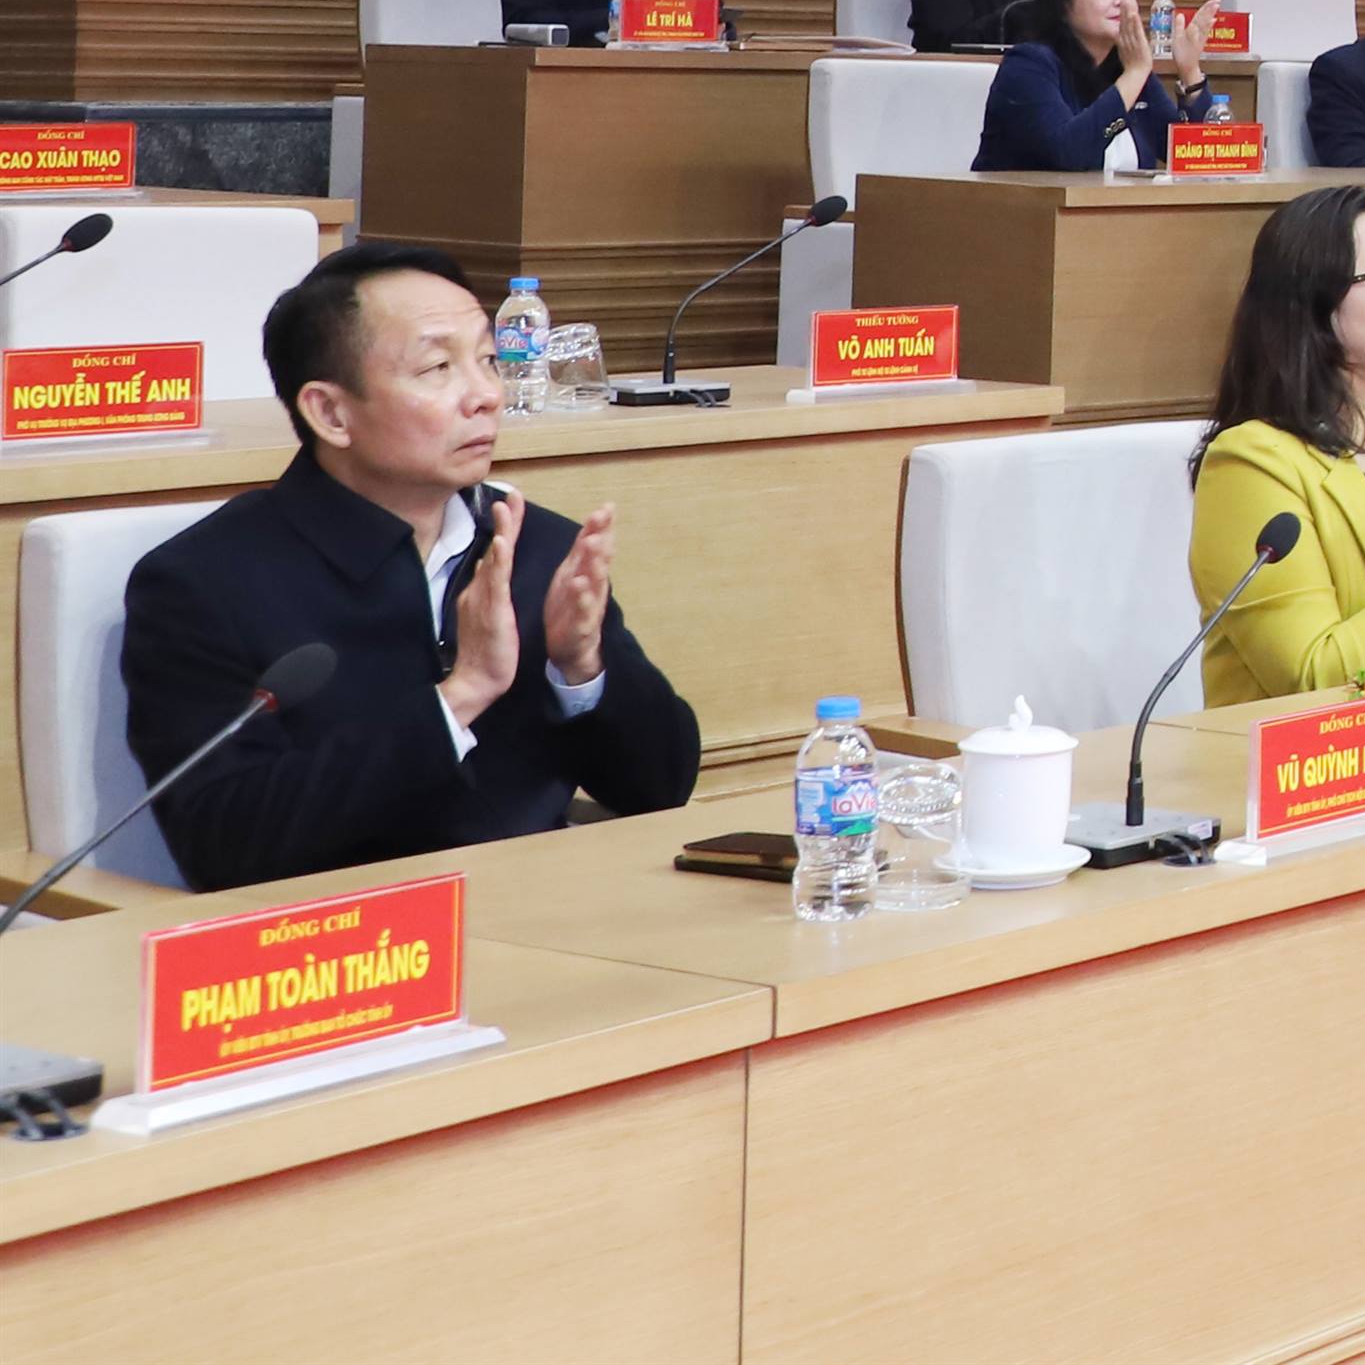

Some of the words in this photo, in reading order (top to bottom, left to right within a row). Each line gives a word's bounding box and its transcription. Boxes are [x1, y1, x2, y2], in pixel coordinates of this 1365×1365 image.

[647, 11, 657, 26] LÊ
[660, 12, 675, 26] TRÍ
[678, 12, 692, 26] HÀ
[0, 152, 33, 169] CAO
[37, 146, 78, 168] XUÂN
[81, 150, 120, 171] THẠO
[838, 336, 860, 359] VÕ
[863, 338, 894, 358] ANH
[898, 329, 934, 356] TUẤN
[72, 354, 109, 368] ĐỒNG
[112, 354, 136, 365] CHÍ
[13, 373, 100, 409] NGUYỄN
[105, 371, 147, 404] THẾ
[146, 378, 190, 402] ANH
[1319, 712, 1353, 734] ĐỒNG
[1277, 754, 1299, 793] VŨ
[1303, 745, 1359, 787] QUỲNH
[258, 916, 320, 946] ĐỒNG
[322, 906, 360, 932] CHÍ
[182, 976, 261, 1033] PHẠM
[266, 954, 338, 1011] TOÀN
[343, 928, 429, 993] THẮNG
